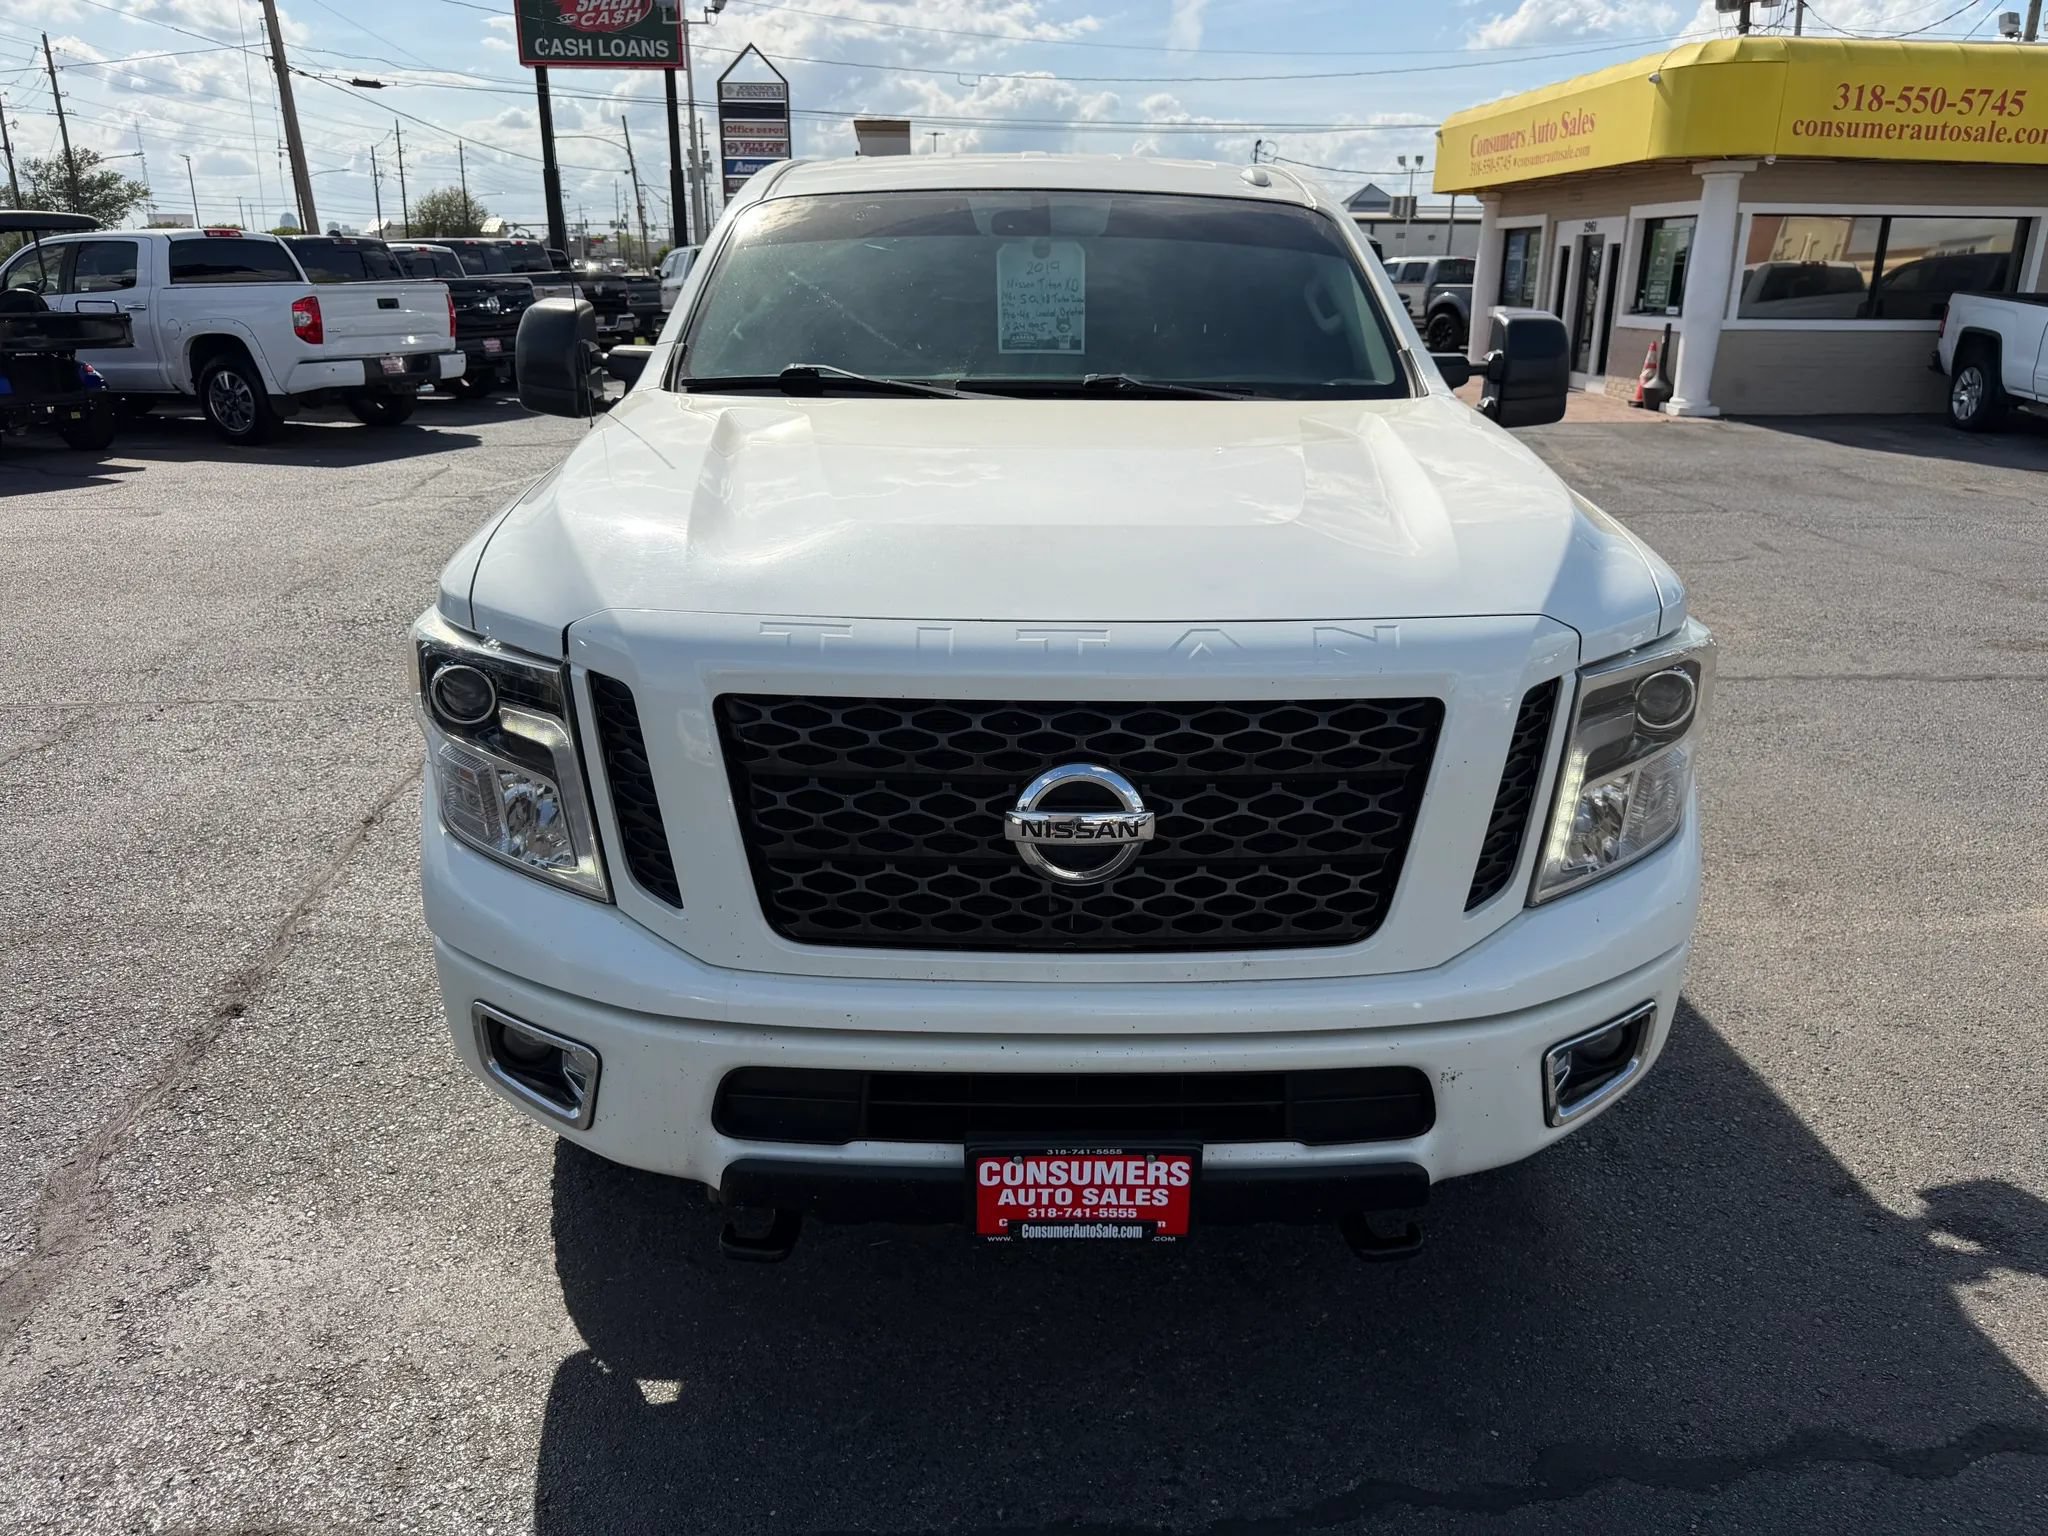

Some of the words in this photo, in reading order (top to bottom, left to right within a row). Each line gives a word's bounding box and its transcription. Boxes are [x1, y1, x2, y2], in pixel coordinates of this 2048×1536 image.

[580, 9, 642, 26] CA$H
[534, 38, 593, 57] CASH
[599, 39, 669, 58] LOANS
[1833, 82, 2028, 117] 318-550-5745
[726, 125, 754, 134] Office
[1470, 129, 1526, 158] Consumers
[1527, 119, 1558, 146] Auto
[1560, 107, 1597, 139] Sales
[759, 621, 1400, 657] TITAN
[1021, 820, 1139, 838] NISSAN
[979, 1160, 1190, 1187] CONSUMERS
[998, 1188, 1073, 1206] AUTO
[1082, 1188, 1169, 1206] SALES
[1027, 1207, 1138, 1218] 318-741-5555
[1021, 1223, 1143, 1239] ConsumerAutoSale.com
